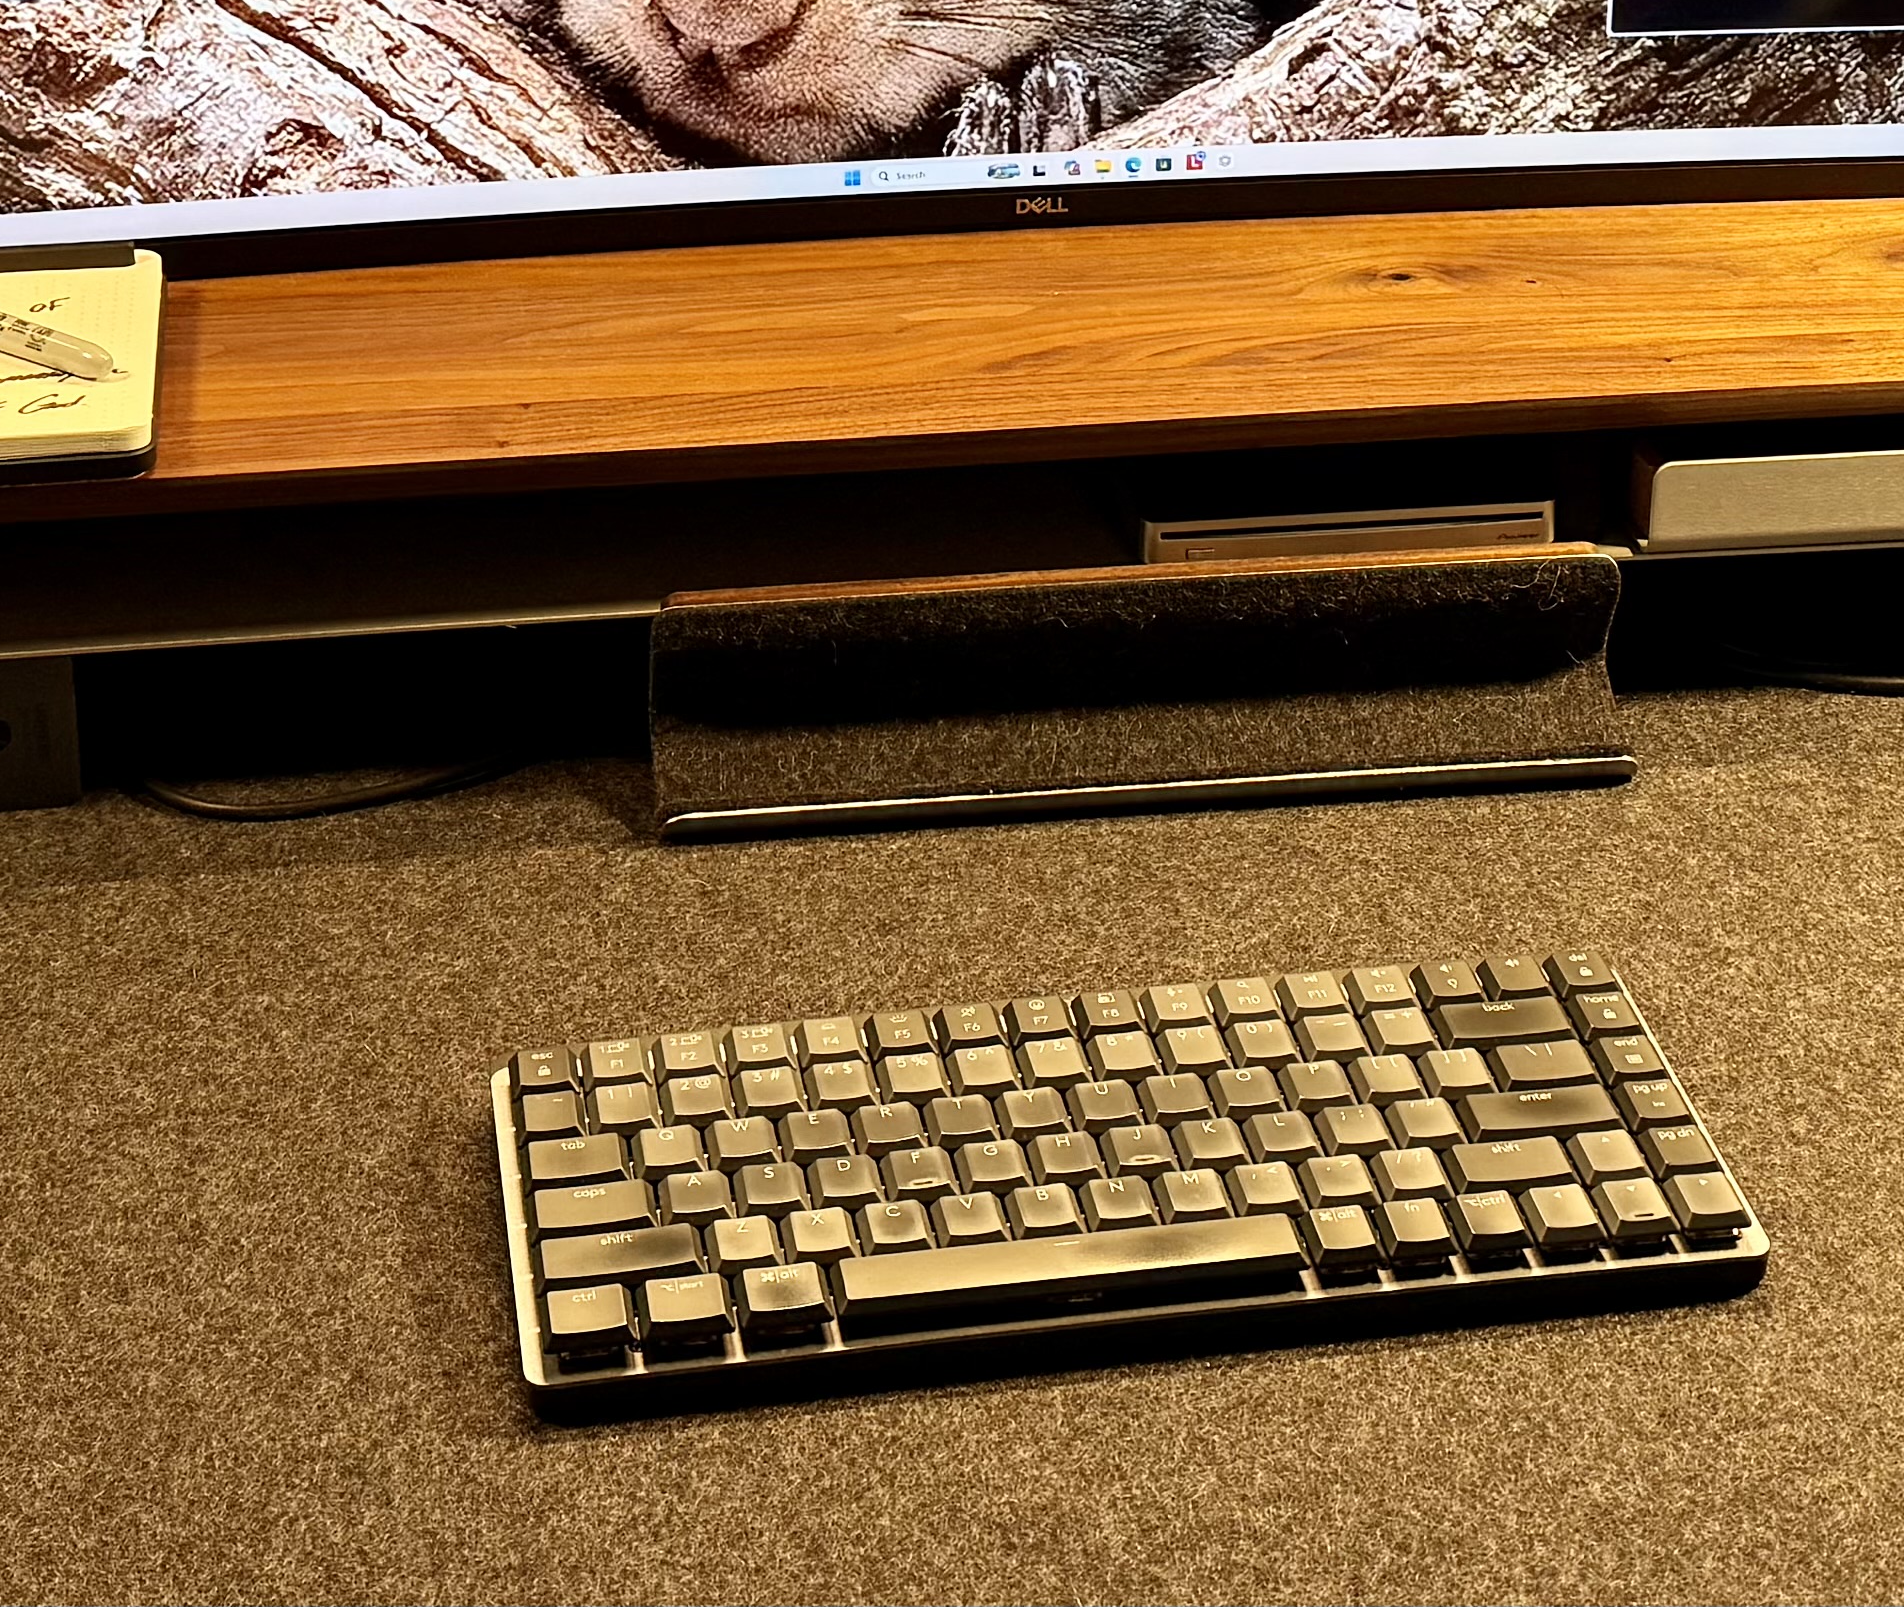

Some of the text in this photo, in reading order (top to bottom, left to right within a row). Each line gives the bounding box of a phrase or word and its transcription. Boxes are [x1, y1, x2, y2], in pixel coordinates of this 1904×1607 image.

[1016, 197, 1068, 214] DELL
[1374, 984, 1397, 993] F12
[1582, 993, 1622, 1005] home
[1482, 1001, 1514, 1011] back
[895, 1029, 910, 1039] F5
[1612, 1036, 1639, 1048] end
[1517, 1091, 1551, 1101] enter
[559, 1140, 585, 1150] tab
[572, 1186, 606, 1198] caps
[600, 1233, 633, 1246] shift
[570, 1291, 596, 1302] ctrl
